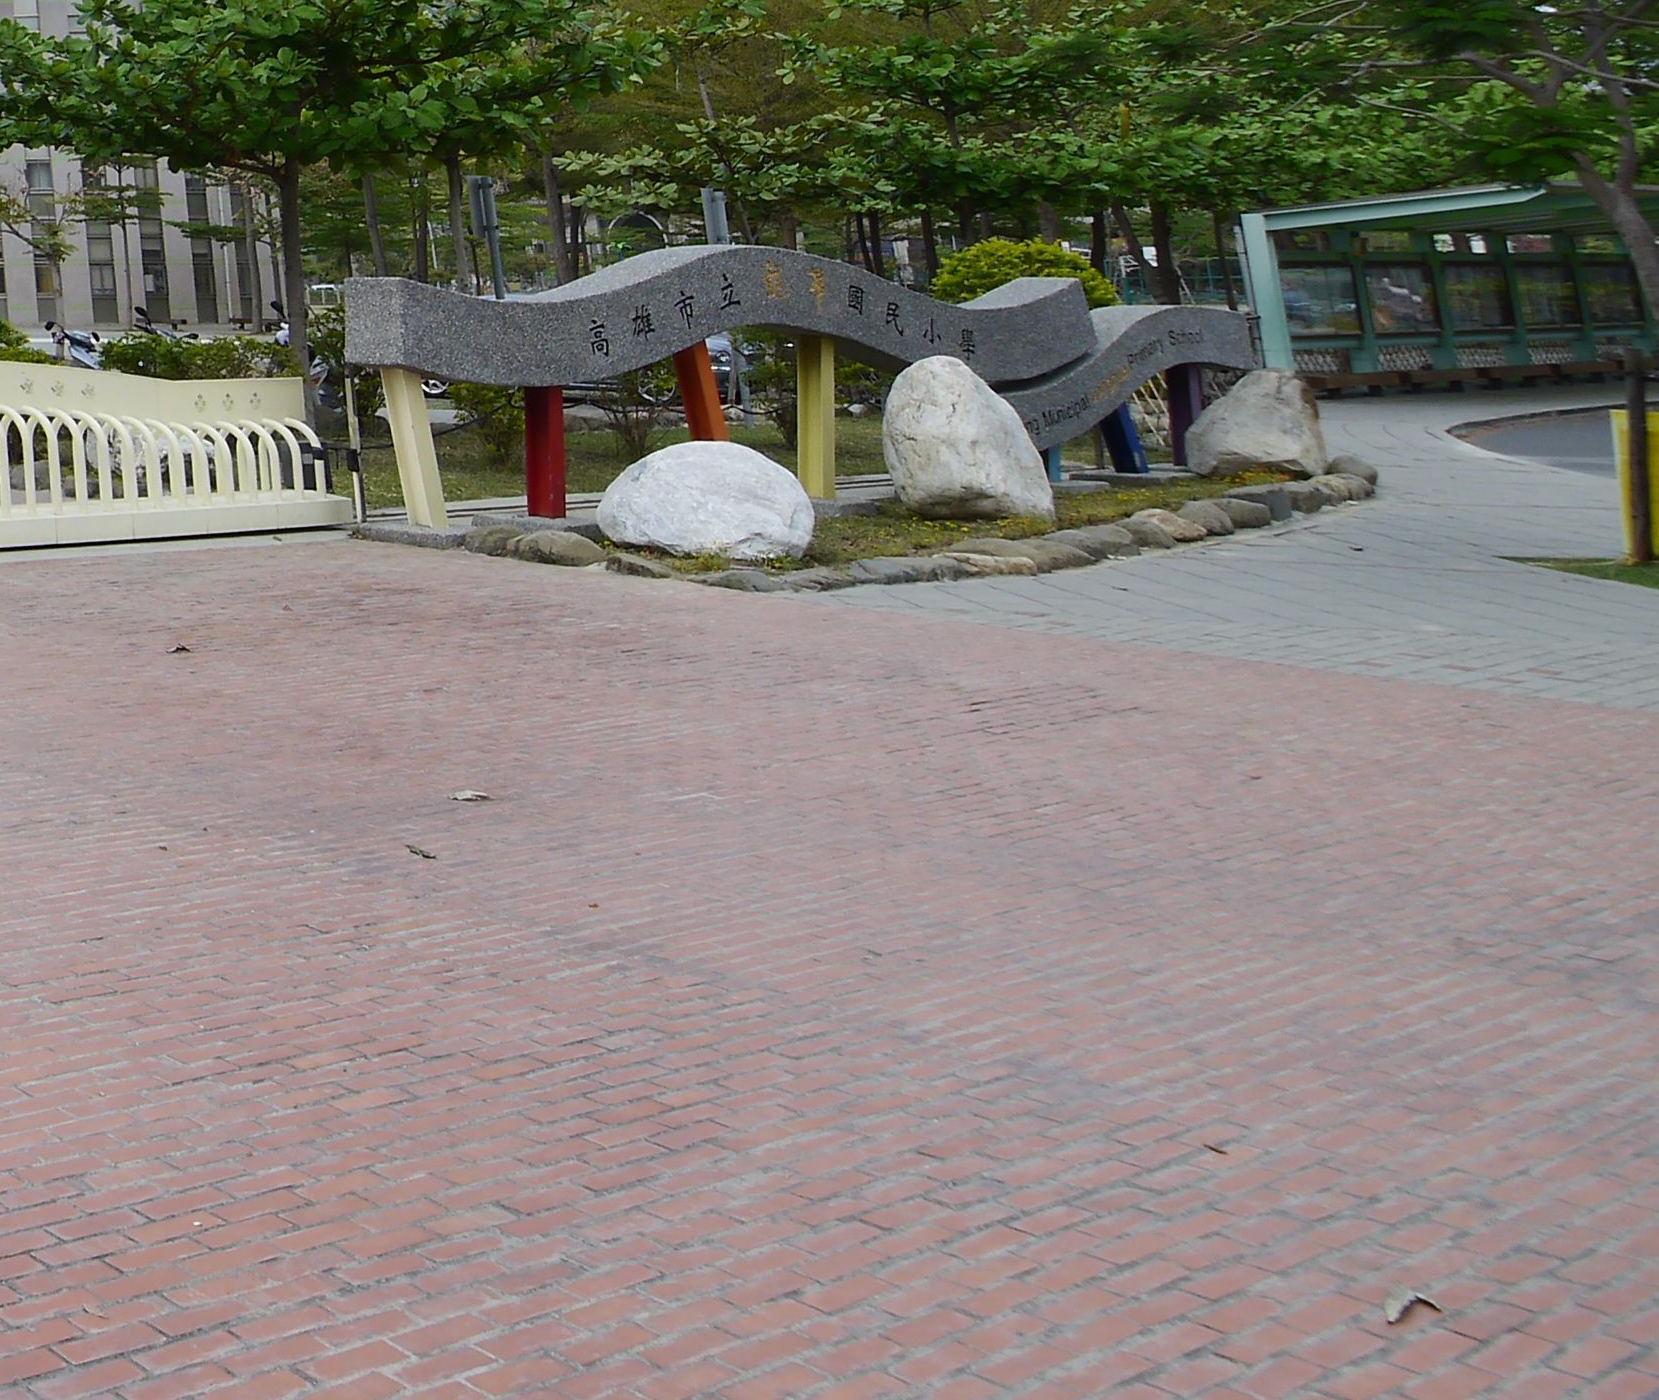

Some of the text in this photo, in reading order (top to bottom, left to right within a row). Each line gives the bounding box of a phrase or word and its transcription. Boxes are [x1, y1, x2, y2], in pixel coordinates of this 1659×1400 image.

[588, 259, 977, 360] 高雄市立龍華國民小學
[1041, 392, 1091, 428] Municipal
[1168, 329, 1204, 346] School
